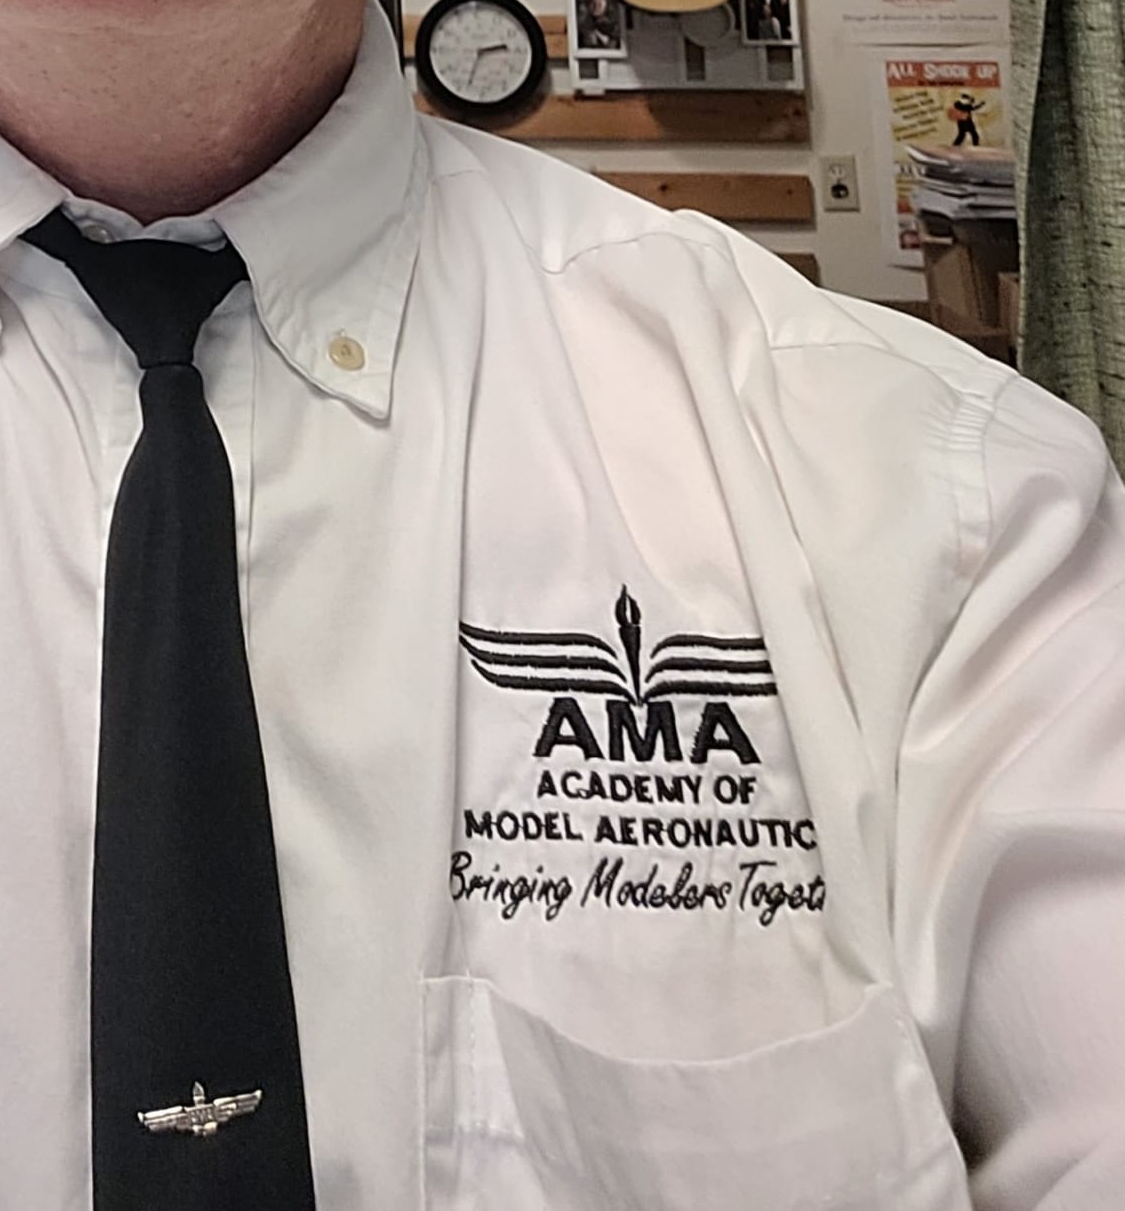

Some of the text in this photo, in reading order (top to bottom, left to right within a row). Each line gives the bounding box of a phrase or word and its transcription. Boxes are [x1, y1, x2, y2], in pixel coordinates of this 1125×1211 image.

[887, 63, 916, 80] ALL
[531, 696, 762, 764] AMA
[537, 769, 757, 804] ACADEMY OF
[464, 809, 818, 851] MODEL AERONAUTIC
[449, 850, 572, 921] Bringing
